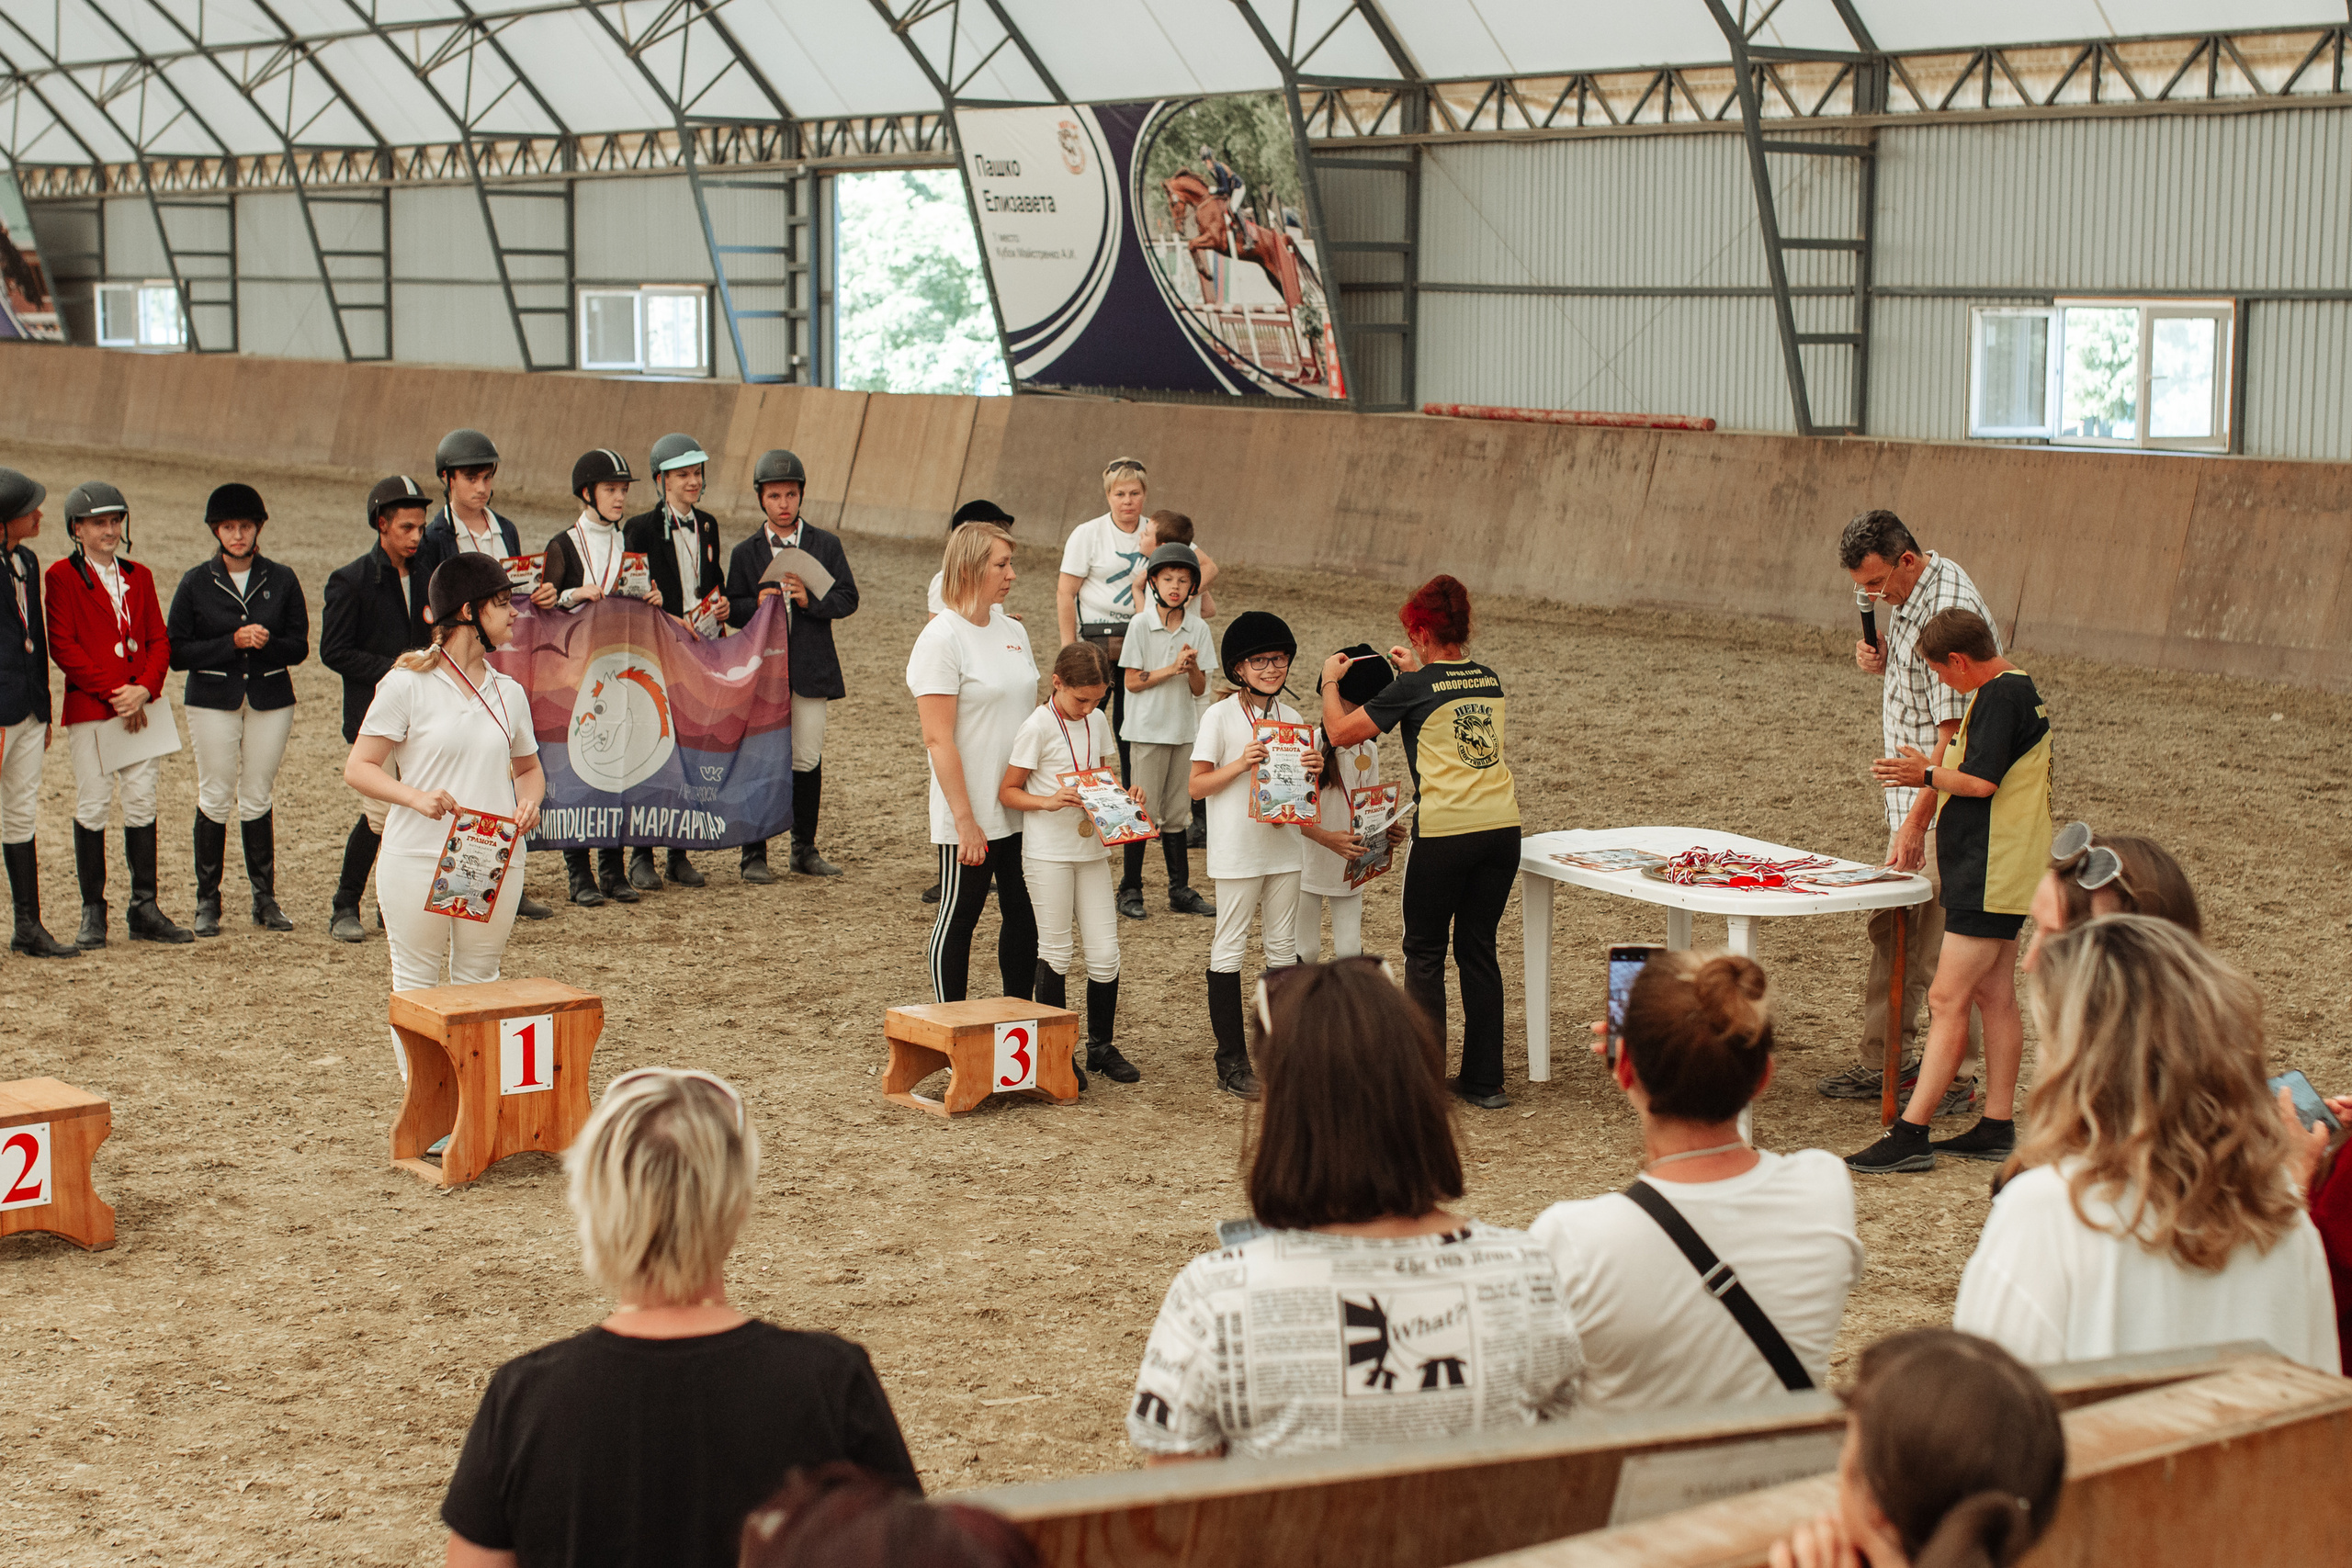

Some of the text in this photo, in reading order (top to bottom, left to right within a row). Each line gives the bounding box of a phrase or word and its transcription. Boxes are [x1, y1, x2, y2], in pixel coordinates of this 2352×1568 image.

[975, 154, 1021, 177] Пашко
[983, 189, 1057, 213] Елизавета
[1431, 675, 1499, 693] НОВОРОССИЙСК
[1453, 704, 1493, 718] ПЕГАС
[467, 835, 497, 847] ГРАМОТА
[512, 1022, 544, 1089] 1
[1000, 1027, 1031, 1087] 3
[1, 1133, 43, 1204] 2
[1390, 1300, 1469, 1342] What?
